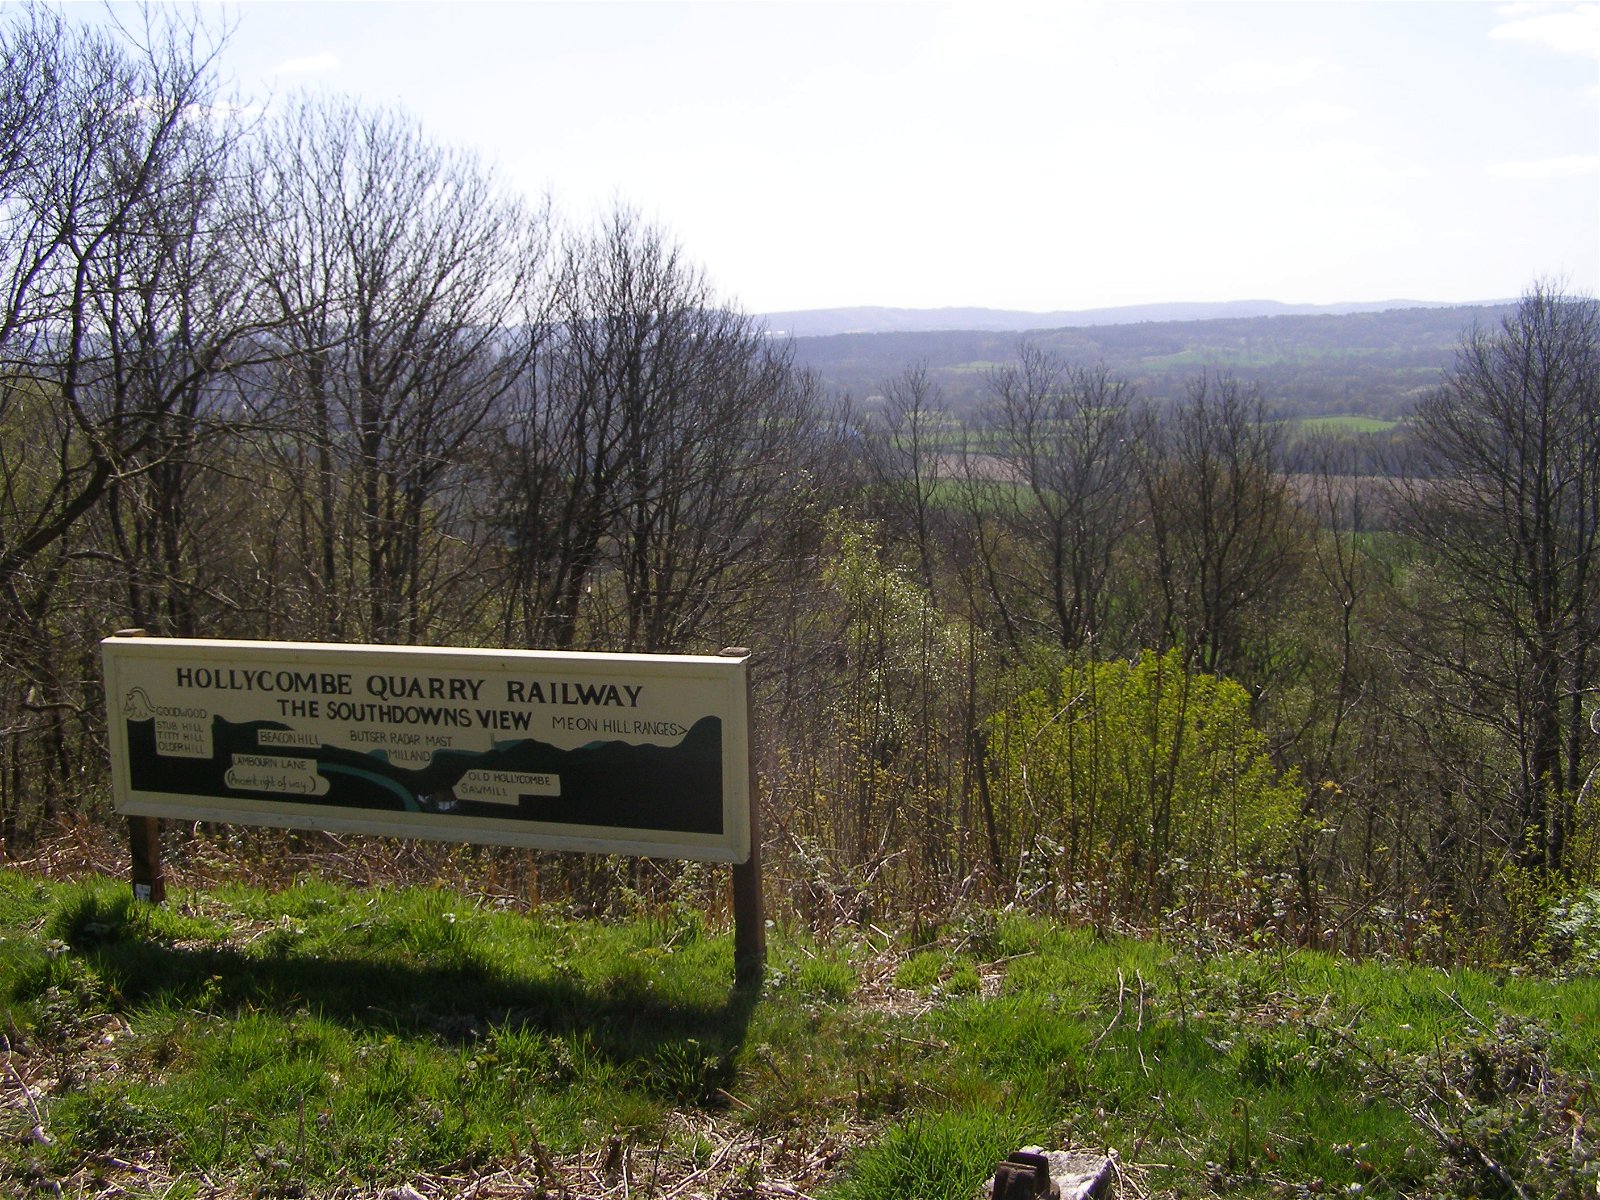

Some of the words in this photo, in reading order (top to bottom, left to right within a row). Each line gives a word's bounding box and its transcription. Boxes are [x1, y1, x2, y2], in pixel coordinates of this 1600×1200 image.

[176, 667, 352, 695] HOLLYCOMBE
[366, 675, 486, 701] QUARRY
[507, 680, 644, 707] RAILWAY
[156, 706, 207, 719] GOODWOOD
[277, 699, 319, 718] THE
[326, 701, 472, 728] SOUTHDOWNS
[476, 709, 533, 731] VIEW
[182, 723, 204, 733] HILL
[552, 716, 598, 732] MEON
[603, 719, 631, 734] HILL
[183, 733, 205, 743] HILL
[260, 731, 296, 743] BEACON
[298, 733, 320, 745] HILL
[350, 730, 386, 743] BUTSER
[390, 732, 421, 745] RADAR
[426, 735, 453, 747] MAST
[388, 749, 430, 762] MILLAND
[281, 759, 307, 770] LANE
[260, 775, 275, 789] right
[277, 775, 286, 790] of
[468, 771, 490, 782] OLD
[493, 774, 551, 786] HOLLYCOMBE
[460, 783, 508, 797] SAWMILL
